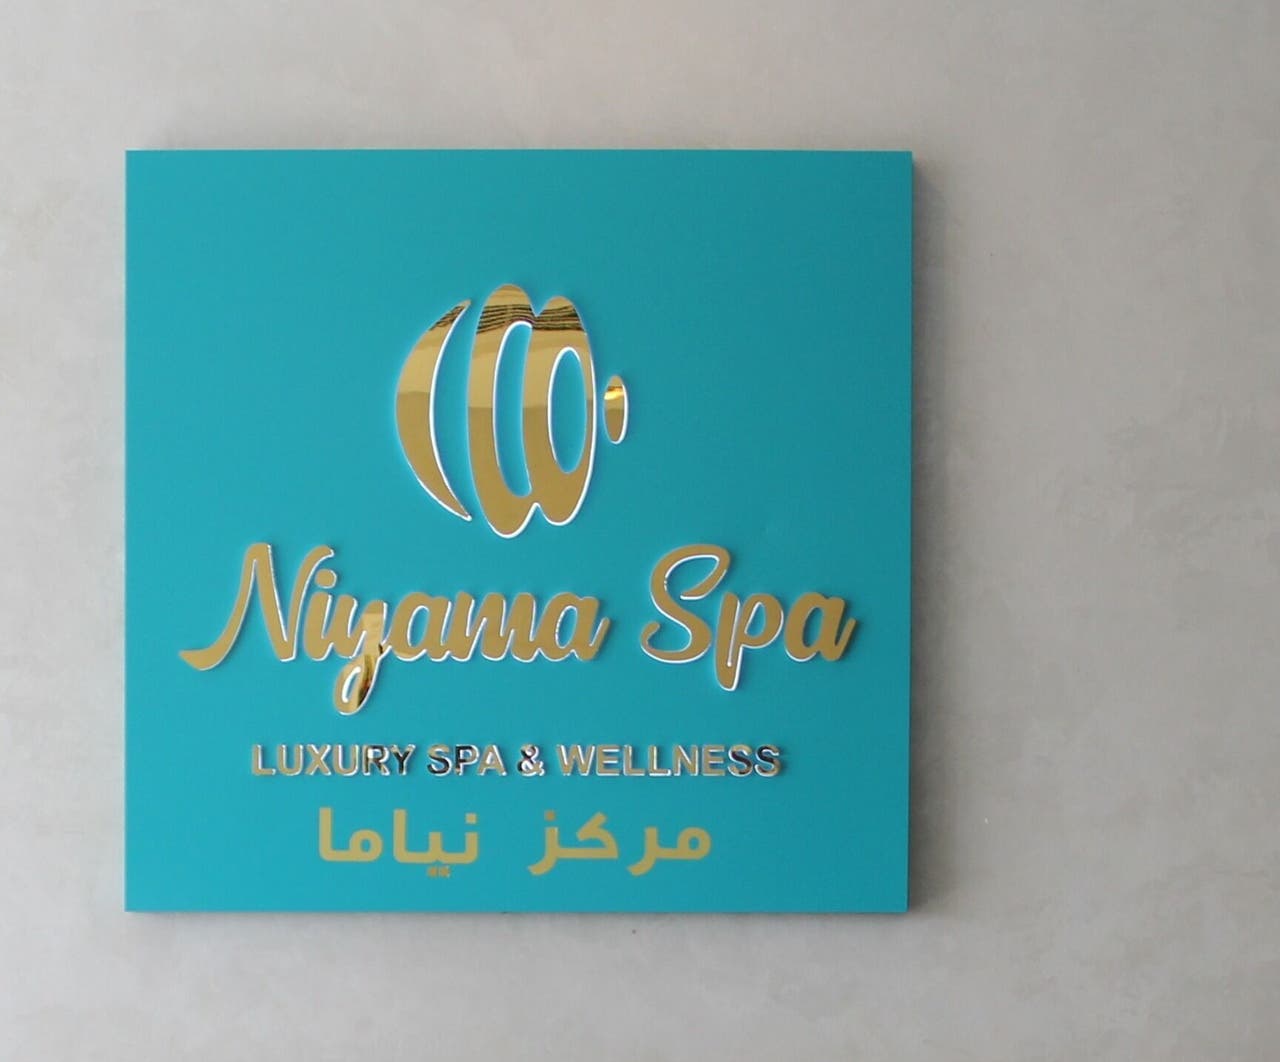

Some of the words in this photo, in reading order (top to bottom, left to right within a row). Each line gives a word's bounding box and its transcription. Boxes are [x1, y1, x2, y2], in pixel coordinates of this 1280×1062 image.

[179, 542, 610, 716] Niyama
[640, 543, 858, 691] Spa
[251, 743, 416, 777] LUXURY
[426, 743, 507, 777] SPA
[517, 743, 547, 777] &
[555, 743, 783, 777] WELLNESS
[318, 806, 480, 878] نياما
[527, 810, 712, 878] مركز
